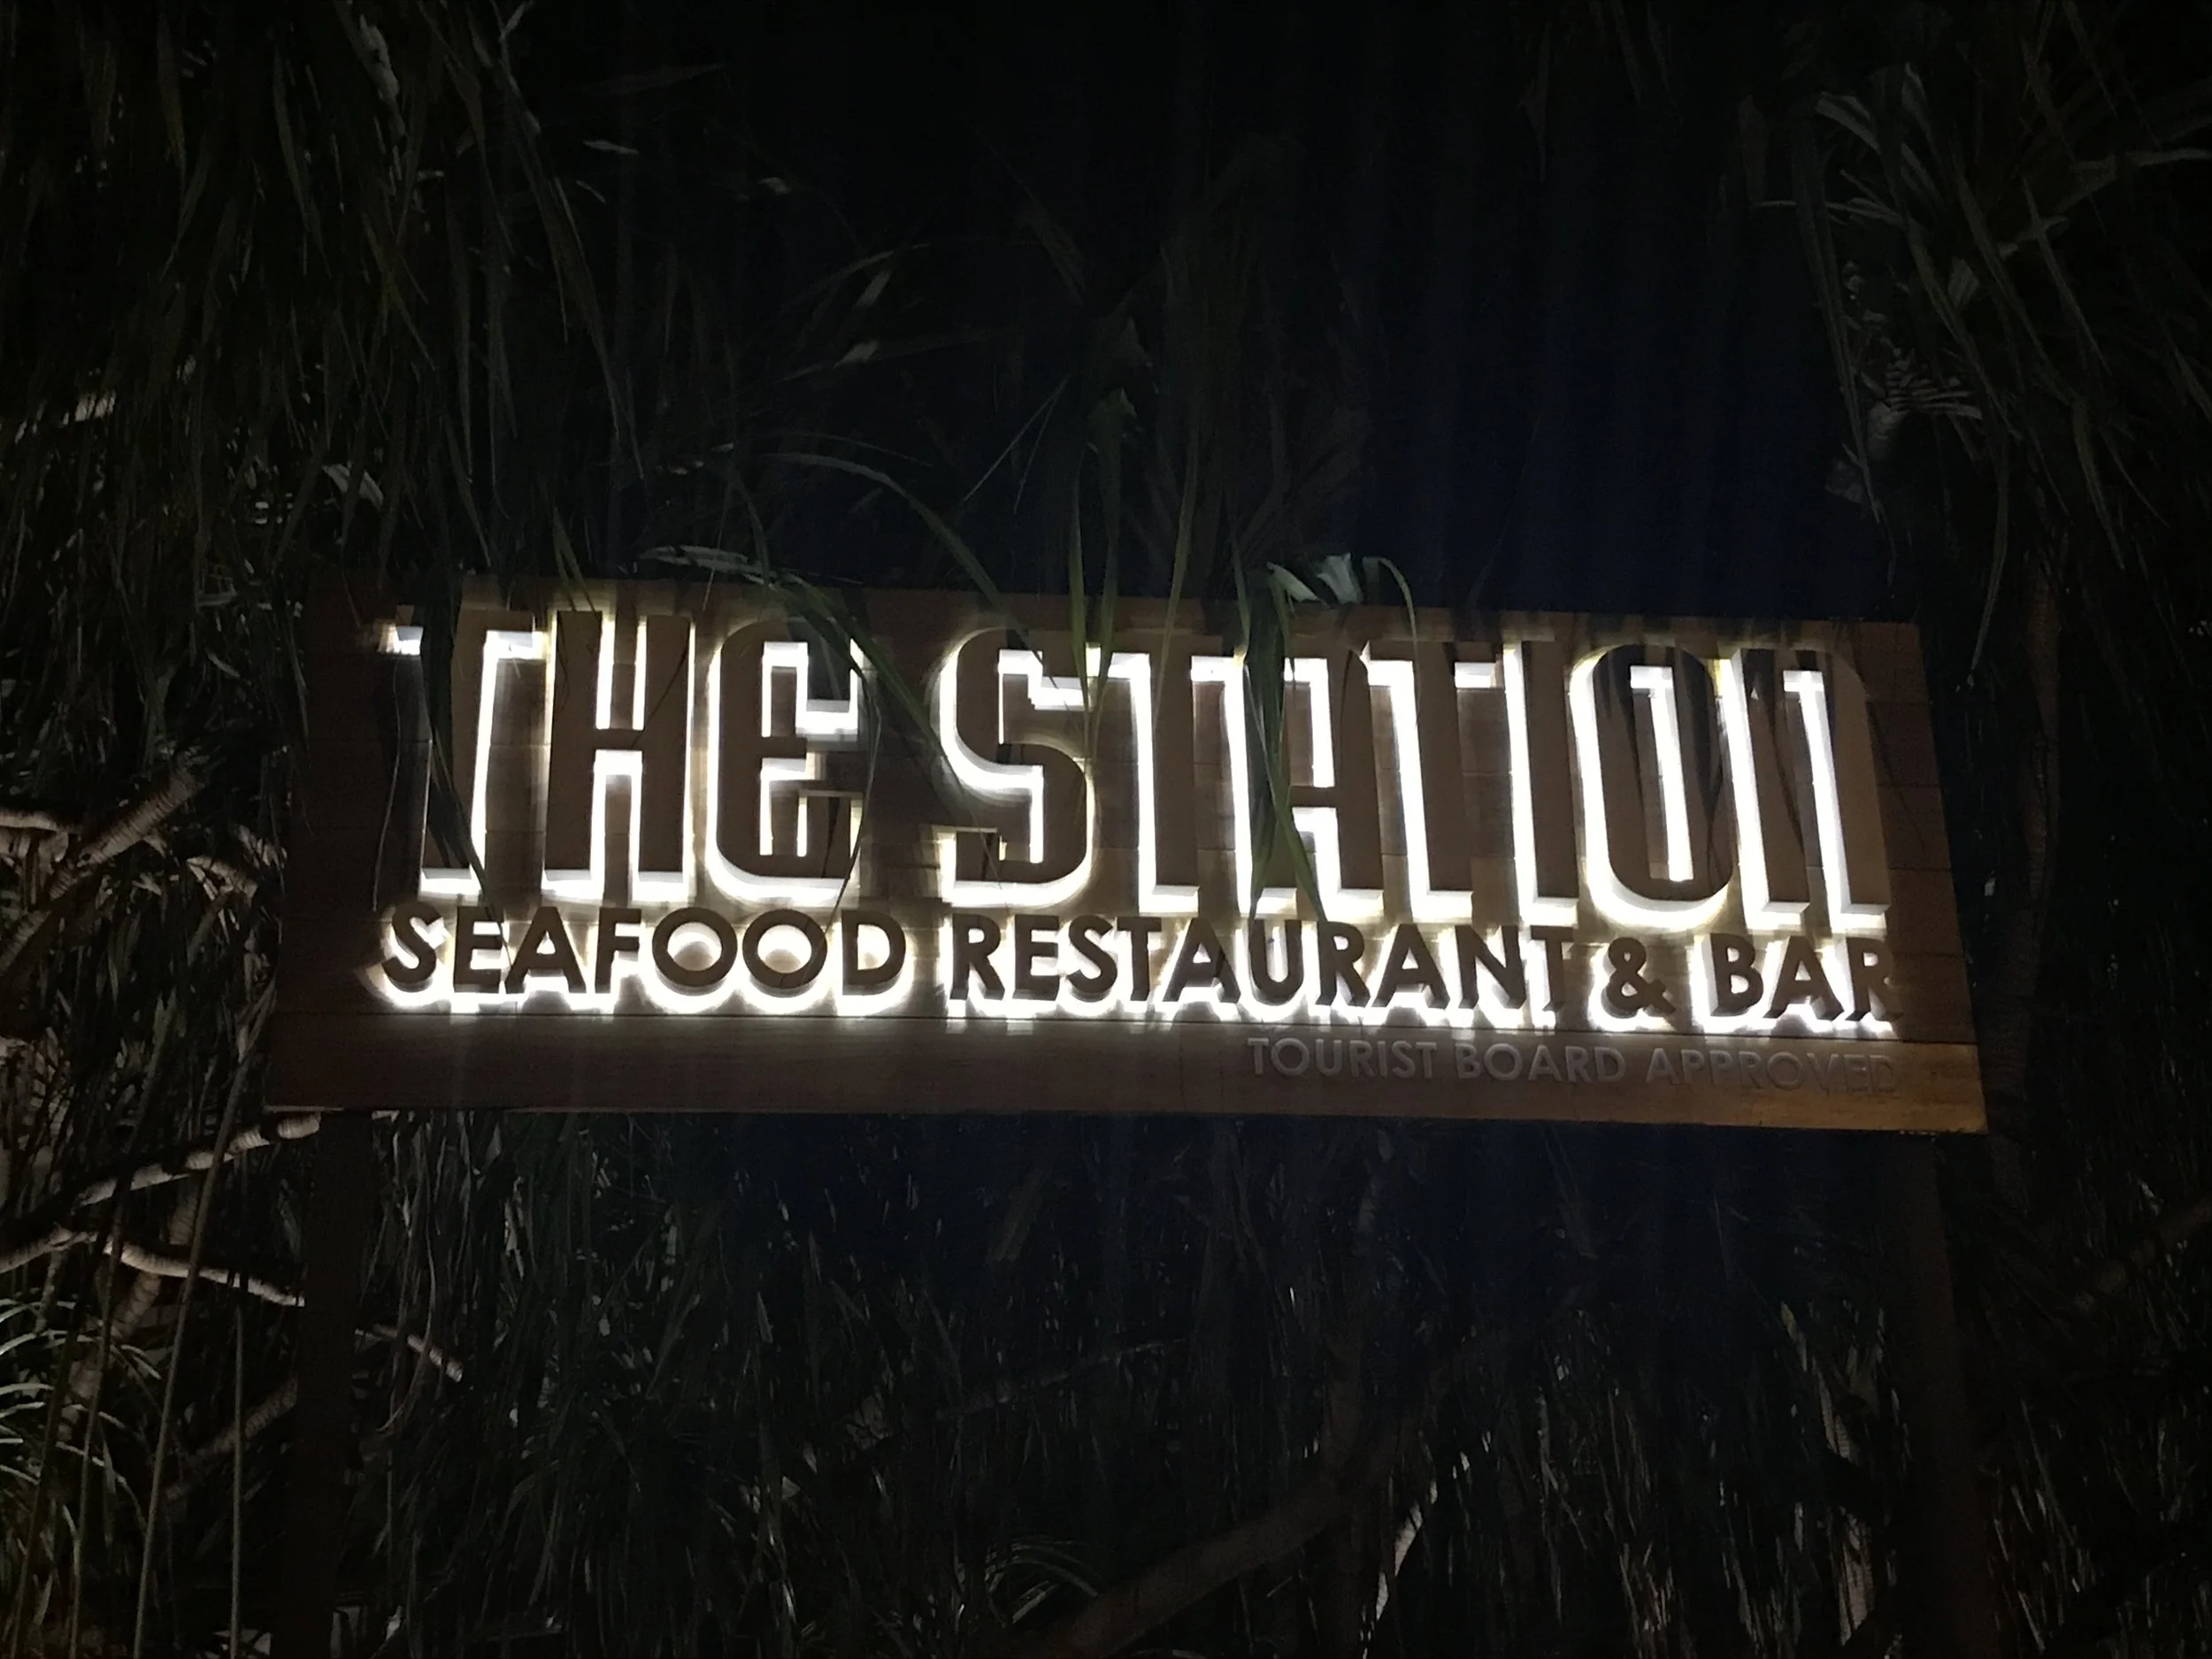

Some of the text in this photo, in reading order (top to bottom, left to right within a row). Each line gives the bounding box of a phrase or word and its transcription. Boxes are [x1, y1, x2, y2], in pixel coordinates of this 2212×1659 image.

[386, 605, 1892, 920] THE STATION
[380, 901, 1902, 1023] SEAFOOD RESTAURANT & BAR
[1247, 1036, 1897, 1094] TOURIST BOARD APPROVED
